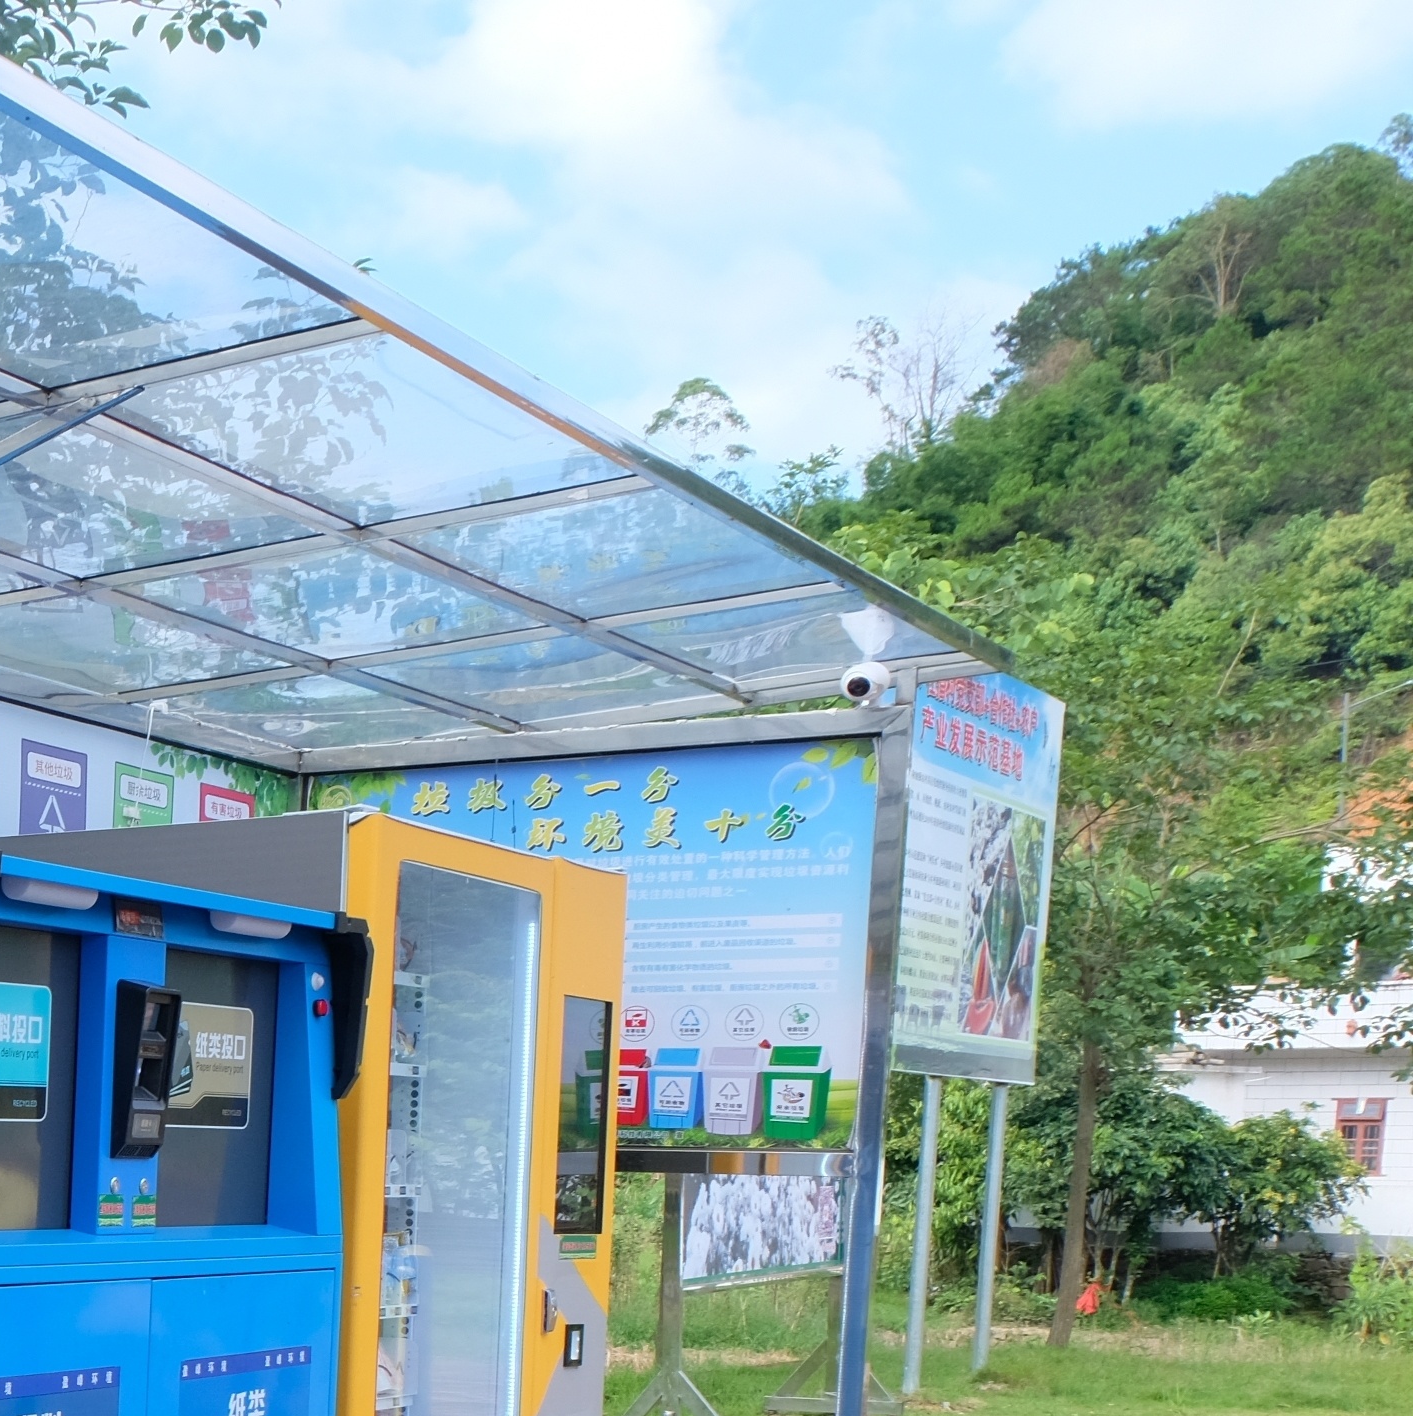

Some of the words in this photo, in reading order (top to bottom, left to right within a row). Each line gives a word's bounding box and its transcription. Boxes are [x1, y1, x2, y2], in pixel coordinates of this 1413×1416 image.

[34, 759, 74, 781] 其他垃圾
[411, 765, 680, 817] 垃圾分一分
[210, 800, 243, 819] 有害垃圾
[525, 802, 807, 853] 环境美十分
[1, 1047, 25, 1061] delivery
[26, 1050, 40, 1062] port
[195, 1031, 247, 1061] 纸类投口
[195, 1061, 211, 1074] Paper
